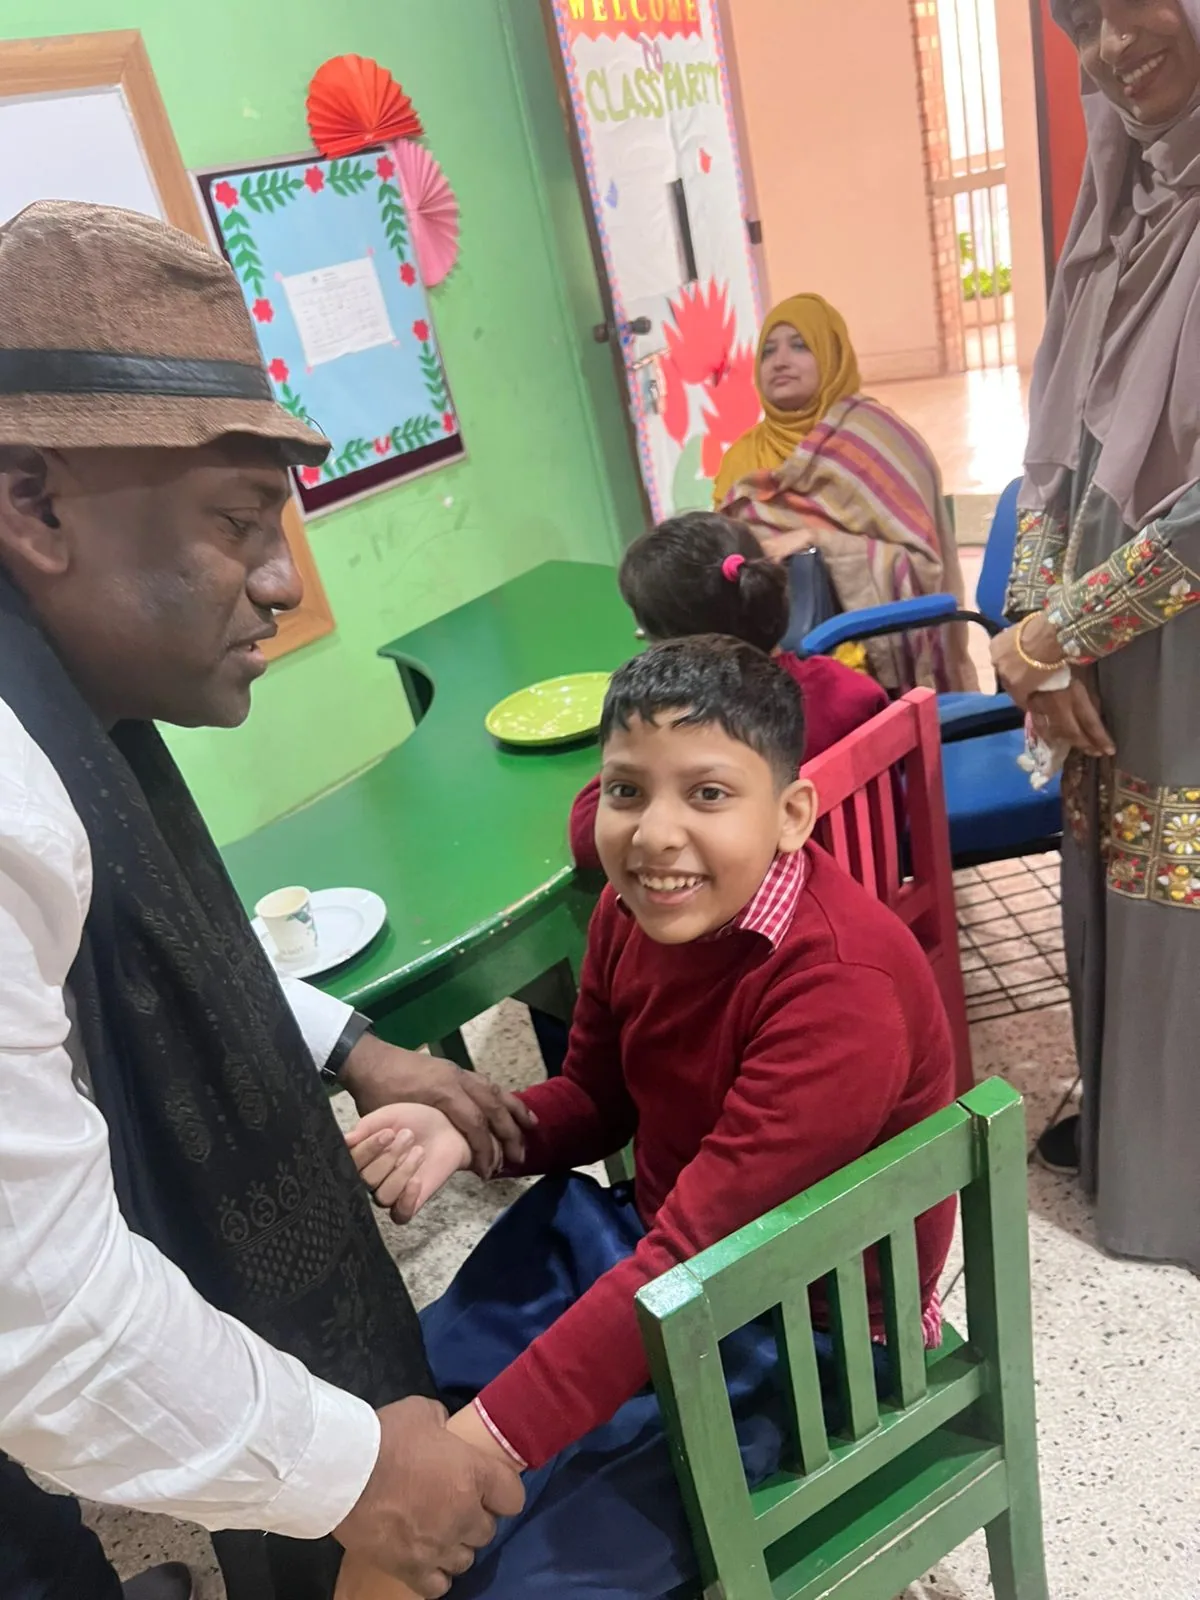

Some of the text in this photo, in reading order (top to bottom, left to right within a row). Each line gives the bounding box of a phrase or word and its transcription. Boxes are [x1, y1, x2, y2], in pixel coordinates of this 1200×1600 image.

[567, 0, 698, 21] WELCOME
[636, 34, 663, 73] TO
[585, 61, 720, 122] CLASS PARTY
